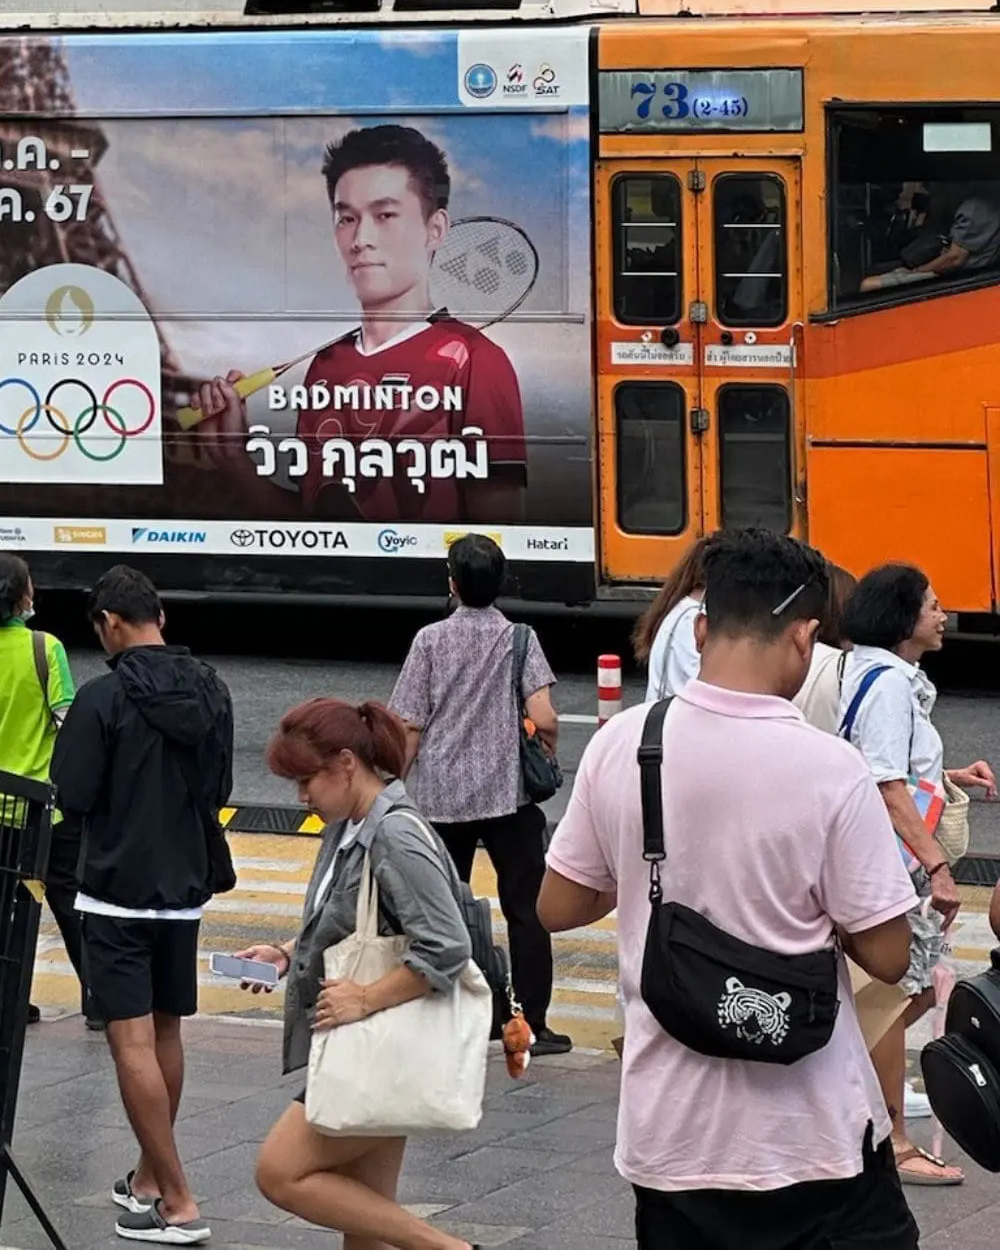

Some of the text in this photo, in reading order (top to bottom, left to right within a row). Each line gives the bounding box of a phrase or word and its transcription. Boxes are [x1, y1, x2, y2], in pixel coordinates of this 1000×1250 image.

[536, 85, 560, 95] SAT
[631, 82, 748, 120] 73 (2-45)
[45, 185, 94, 223] 67
[76, 352, 124, 366] 2024
[267, 384, 464, 412] BADMINTON
[246, 425, 489, 495] วิว กุลวุฒิ
[147, 531, 207, 543] DAIKIN
[254, 529, 349, 549] TOYOTA
[526, 537, 568, 550] Hatari
